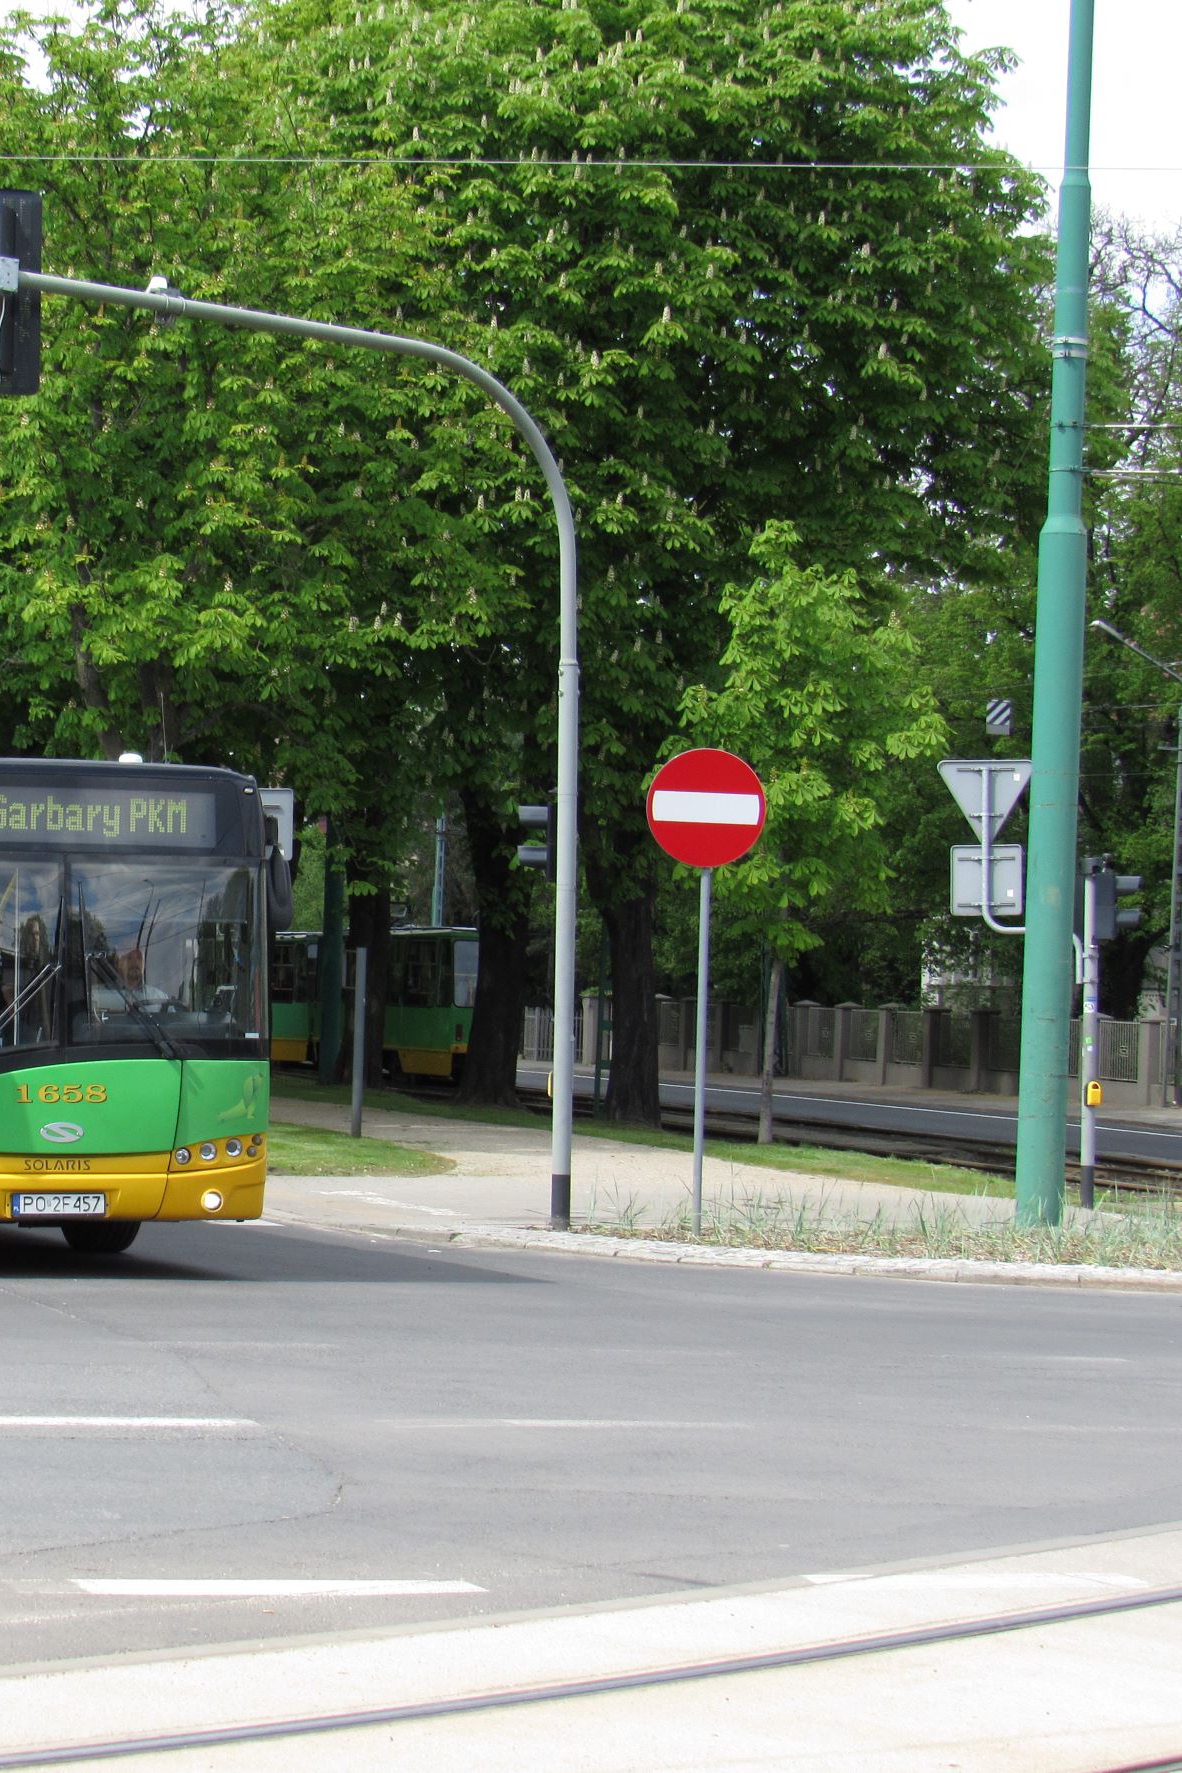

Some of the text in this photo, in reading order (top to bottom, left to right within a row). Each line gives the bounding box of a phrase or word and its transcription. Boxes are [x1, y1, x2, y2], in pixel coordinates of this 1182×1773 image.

[129, 797, 187, 834] PKM
[16, 1083, 108, 1104] 1658
[24, 1159, 91, 1171] SOLARIS
[23, 1195, 46, 1212] PO
[53, 1195, 101, 1212] 2F457
